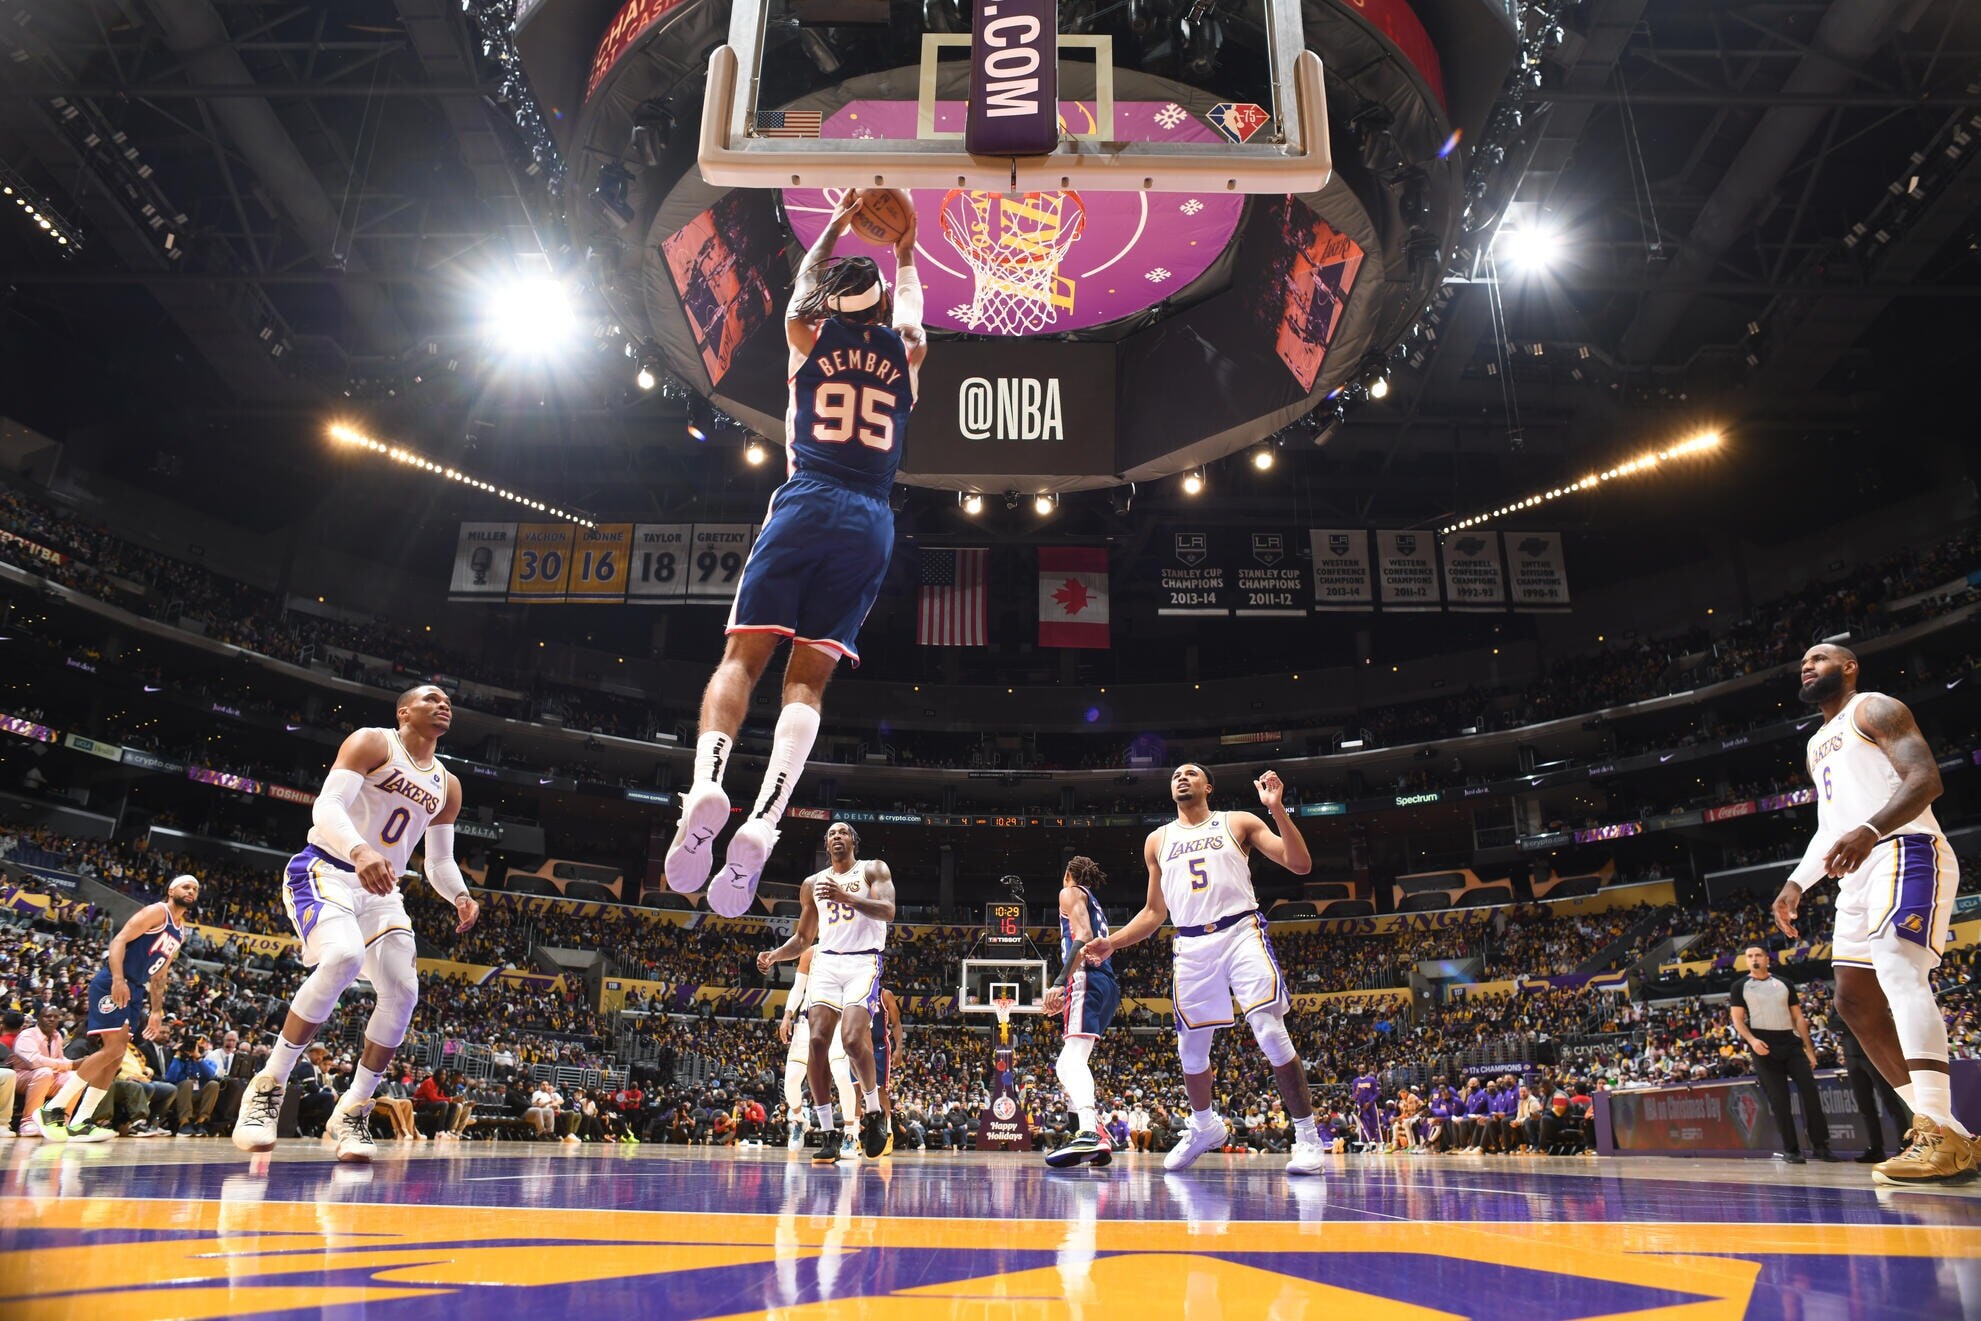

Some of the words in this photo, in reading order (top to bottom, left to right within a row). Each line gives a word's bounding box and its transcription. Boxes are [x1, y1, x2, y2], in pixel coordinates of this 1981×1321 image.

[984, 0, 1040, 118] .COM
[1244, 110, 1256, 122] 75
[816, 349, 901, 385] BEMBRY
[959, 377, 1064, 440] @NBA
[812, 381, 897, 451] 95
[467, 531, 507, 542] MILLER
[525, 532, 566, 542] VACHON
[643, 533, 682, 543] TAYLOR
[697, 532, 744, 543] GRETZKY
[518, 551, 563, 581] 30
[581, 551, 616, 582] 16
[641, 552, 676, 583] 18
[696, 552, 742, 583] 99
[1316, 568, 1366, 576] CONFERENCE
[1161, 569, 1201, 578] STANLEY
[1204, 568, 1223, 577] CUP
[1238, 569, 1278, 578] STANLEY
[1281, 569, 1300, 578] CUP
[1162, 578, 1224, 588] CHAMPIONS
[1239, 579, 1301, 589] CHAMPIONS
[1170, 592, 1216, 604] 2013-14
[1326, 588, 1360, 596] 2013-14
[1249, 593, 1293, 605] 2011-12
[134, 755, 183, 772] crypto.com
[1823, 766, 1833, 802] 6
[270, 785, 317, 804] TOSHIBA
[374, 767, 440, 815] LAKERS
[1396, 792, 1438, 806] Spectrum
[844, 812, 875, 821] DELTA
[885, 814, 922, 823] crypto.com
[380, 806, 411, 848] 0
[464, 825, 495, 837] DELTA
[1166, 836, 1224, 862] LAKERS
[1188, 858, 1209, 893] 5
[1959, 899, 1978, 909] UCLA
[995, 906, 1020, 917] 10:29
[1001, 918, 1017, 935] 16
[250, 938, 281, 951] LOS
[147, 956, 166, 976] 8
[1469, 1066, 1480, 1074] 17x
[1480, 1063, 1522, 1073] CHAMPIONS
[1819, 1086, 1859, 1114] istmas
[1667, 1094, 1705, 1120] Christmas
[990, 1122, 1018, 1131] Happy
[986, 1132, 1023, 1142] Holidays
[1682, 1128, 1703, 1139] ESPN
